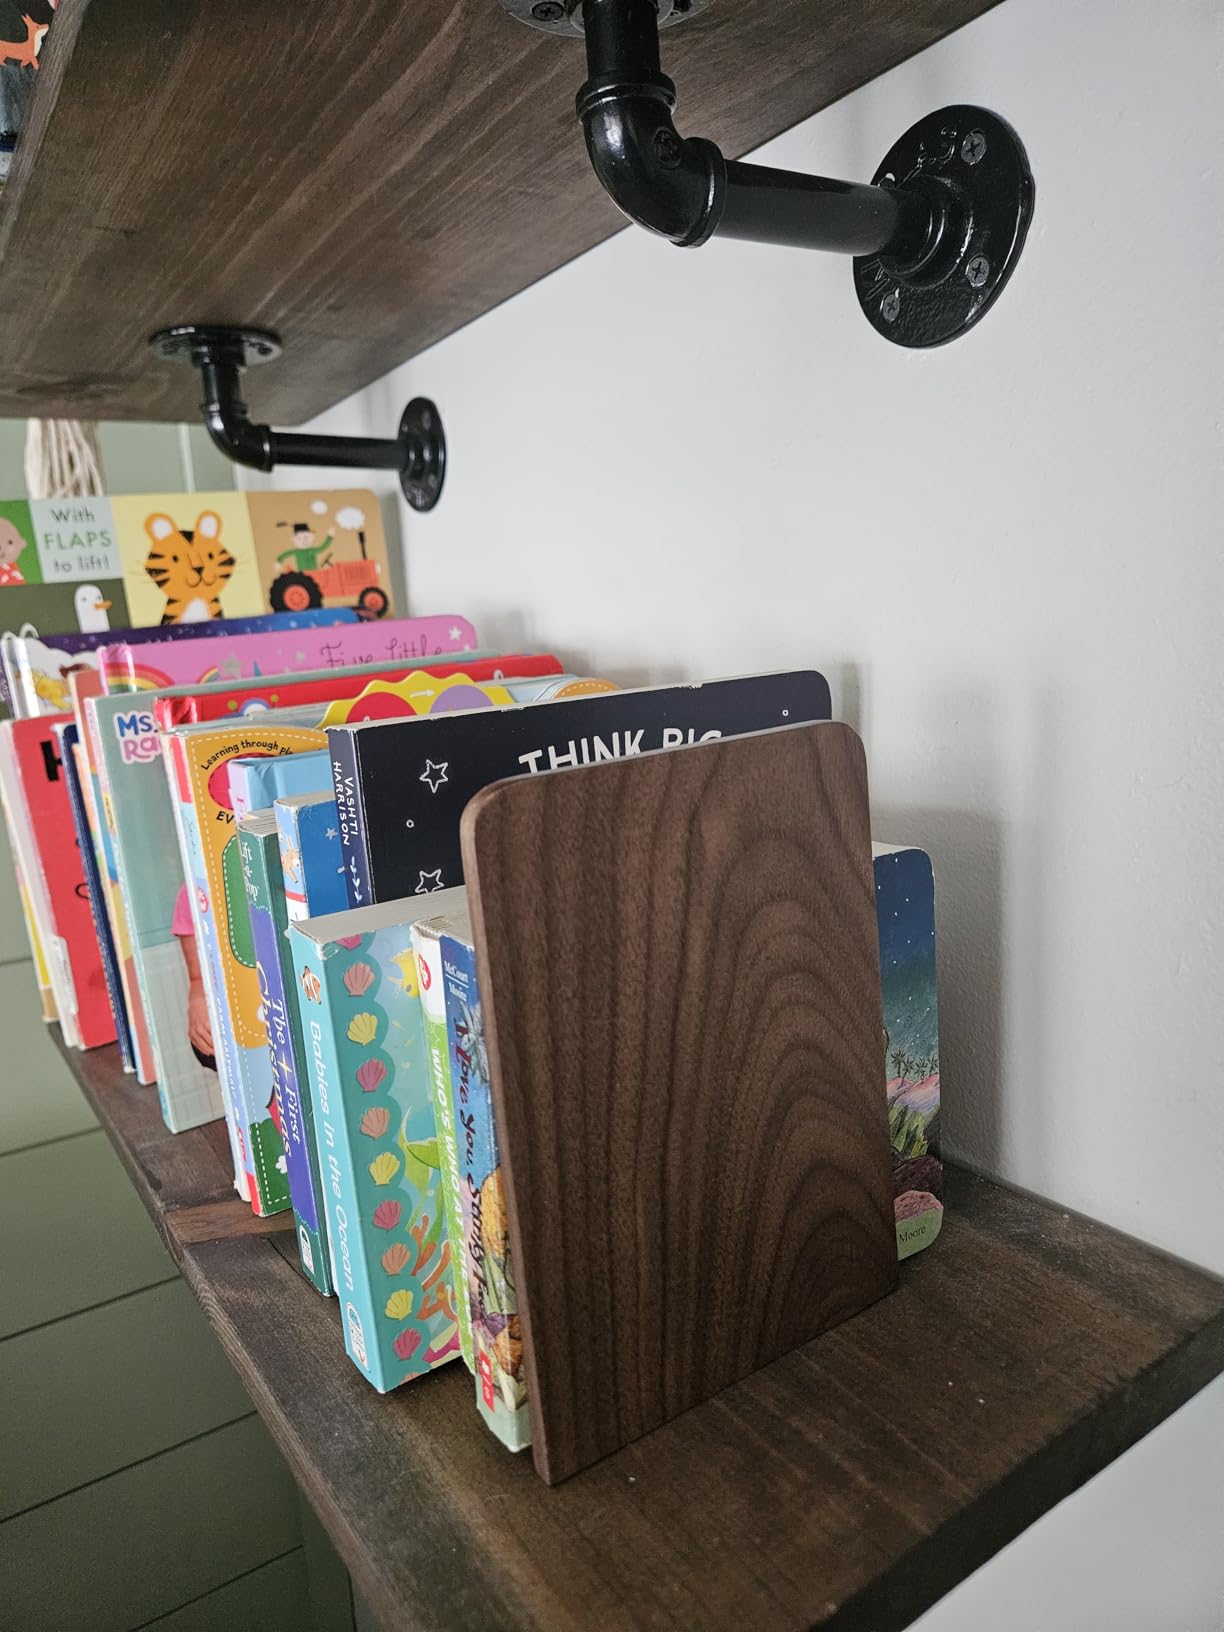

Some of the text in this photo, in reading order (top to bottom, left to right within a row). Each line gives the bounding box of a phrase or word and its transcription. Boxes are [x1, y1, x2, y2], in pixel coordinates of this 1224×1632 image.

[51, 505, 95, 521] With
[44, 530, 112, 550] FLAPS
[54, 559, 72, 572] to
[123, 736, 158, 760] Ra
[201, 739, 294, 770] Learning through pla
[518, 729, 645, 774] THINK
[216, 811, 235, 824] EV
[333, 761, 350, 845] HARRISON
[344, 777, 359, 835] VASHTI
[256, 960, 292, 1157] Christmas
[271, 999, 300, 1144] The First
[432, 1048, 450, 1129] WHO'S
[444, 1134, 461, 1192] WHO
[310, 1021, 354, 1291] Babies in the Ocean
[455, 1043, 472, 1105] Love
[467, 1172, 484, 1268] Stinky
[899, 1225, 927, 1242] Moore
